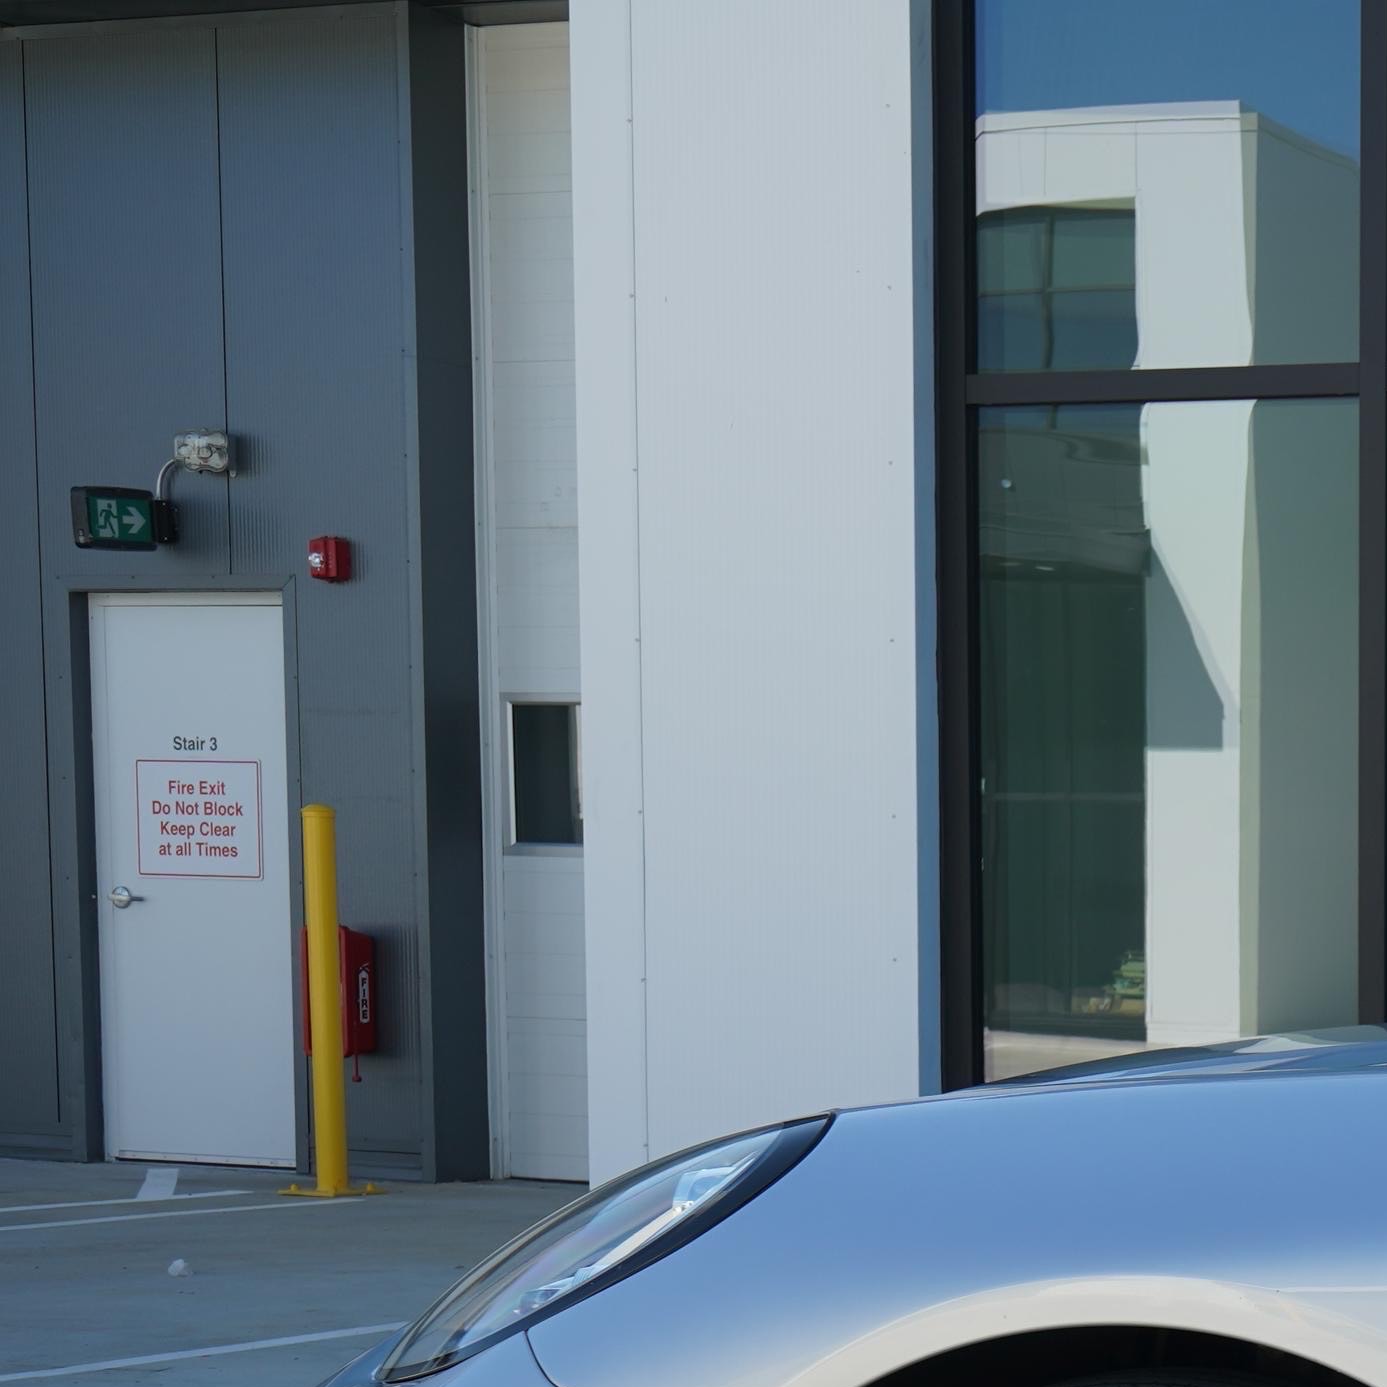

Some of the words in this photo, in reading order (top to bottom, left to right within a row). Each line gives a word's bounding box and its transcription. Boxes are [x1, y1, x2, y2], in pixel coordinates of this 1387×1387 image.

[173, 736, 206, 751] Stair
[209, 737, 218, 751] 3
[168, 780, 195, 795] Fire
[199, 780, 226, 795] Exit
[152, 800, 171, 815] Do
[175, 801, 199, 816] Not
[203, 801, 244, 816] Block
[160, 821, 195, 839] Keep
[199, 821, 236, 837] Clear
[159, 842, 172, 856] at
[175, 842, 191, 857] all
[196, 842, 238, 858] Times
